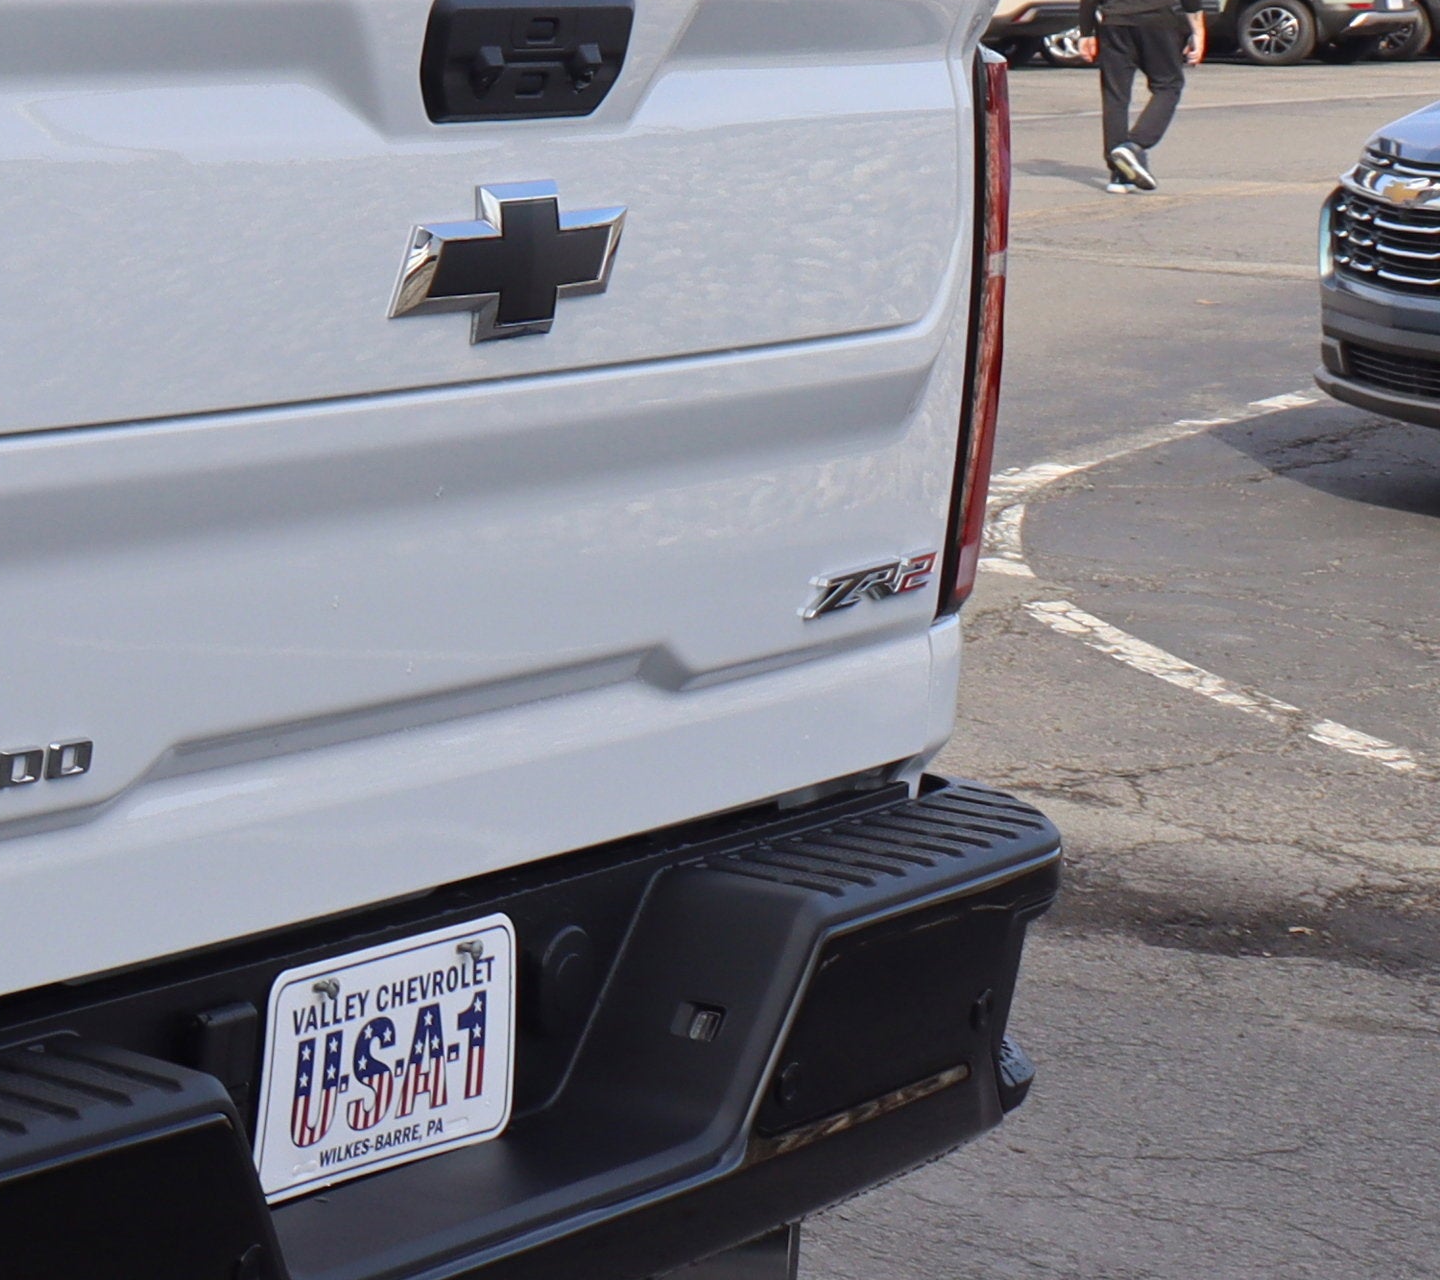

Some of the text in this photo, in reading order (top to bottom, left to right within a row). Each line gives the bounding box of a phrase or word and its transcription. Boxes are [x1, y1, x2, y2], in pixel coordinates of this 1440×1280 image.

[797, 549, 938, 620] ZR2
[292, 956, 496, 1036] VALLEY CHEVROLET
[319, 1117, 444, 1168] WILKES-BARRE, PA
